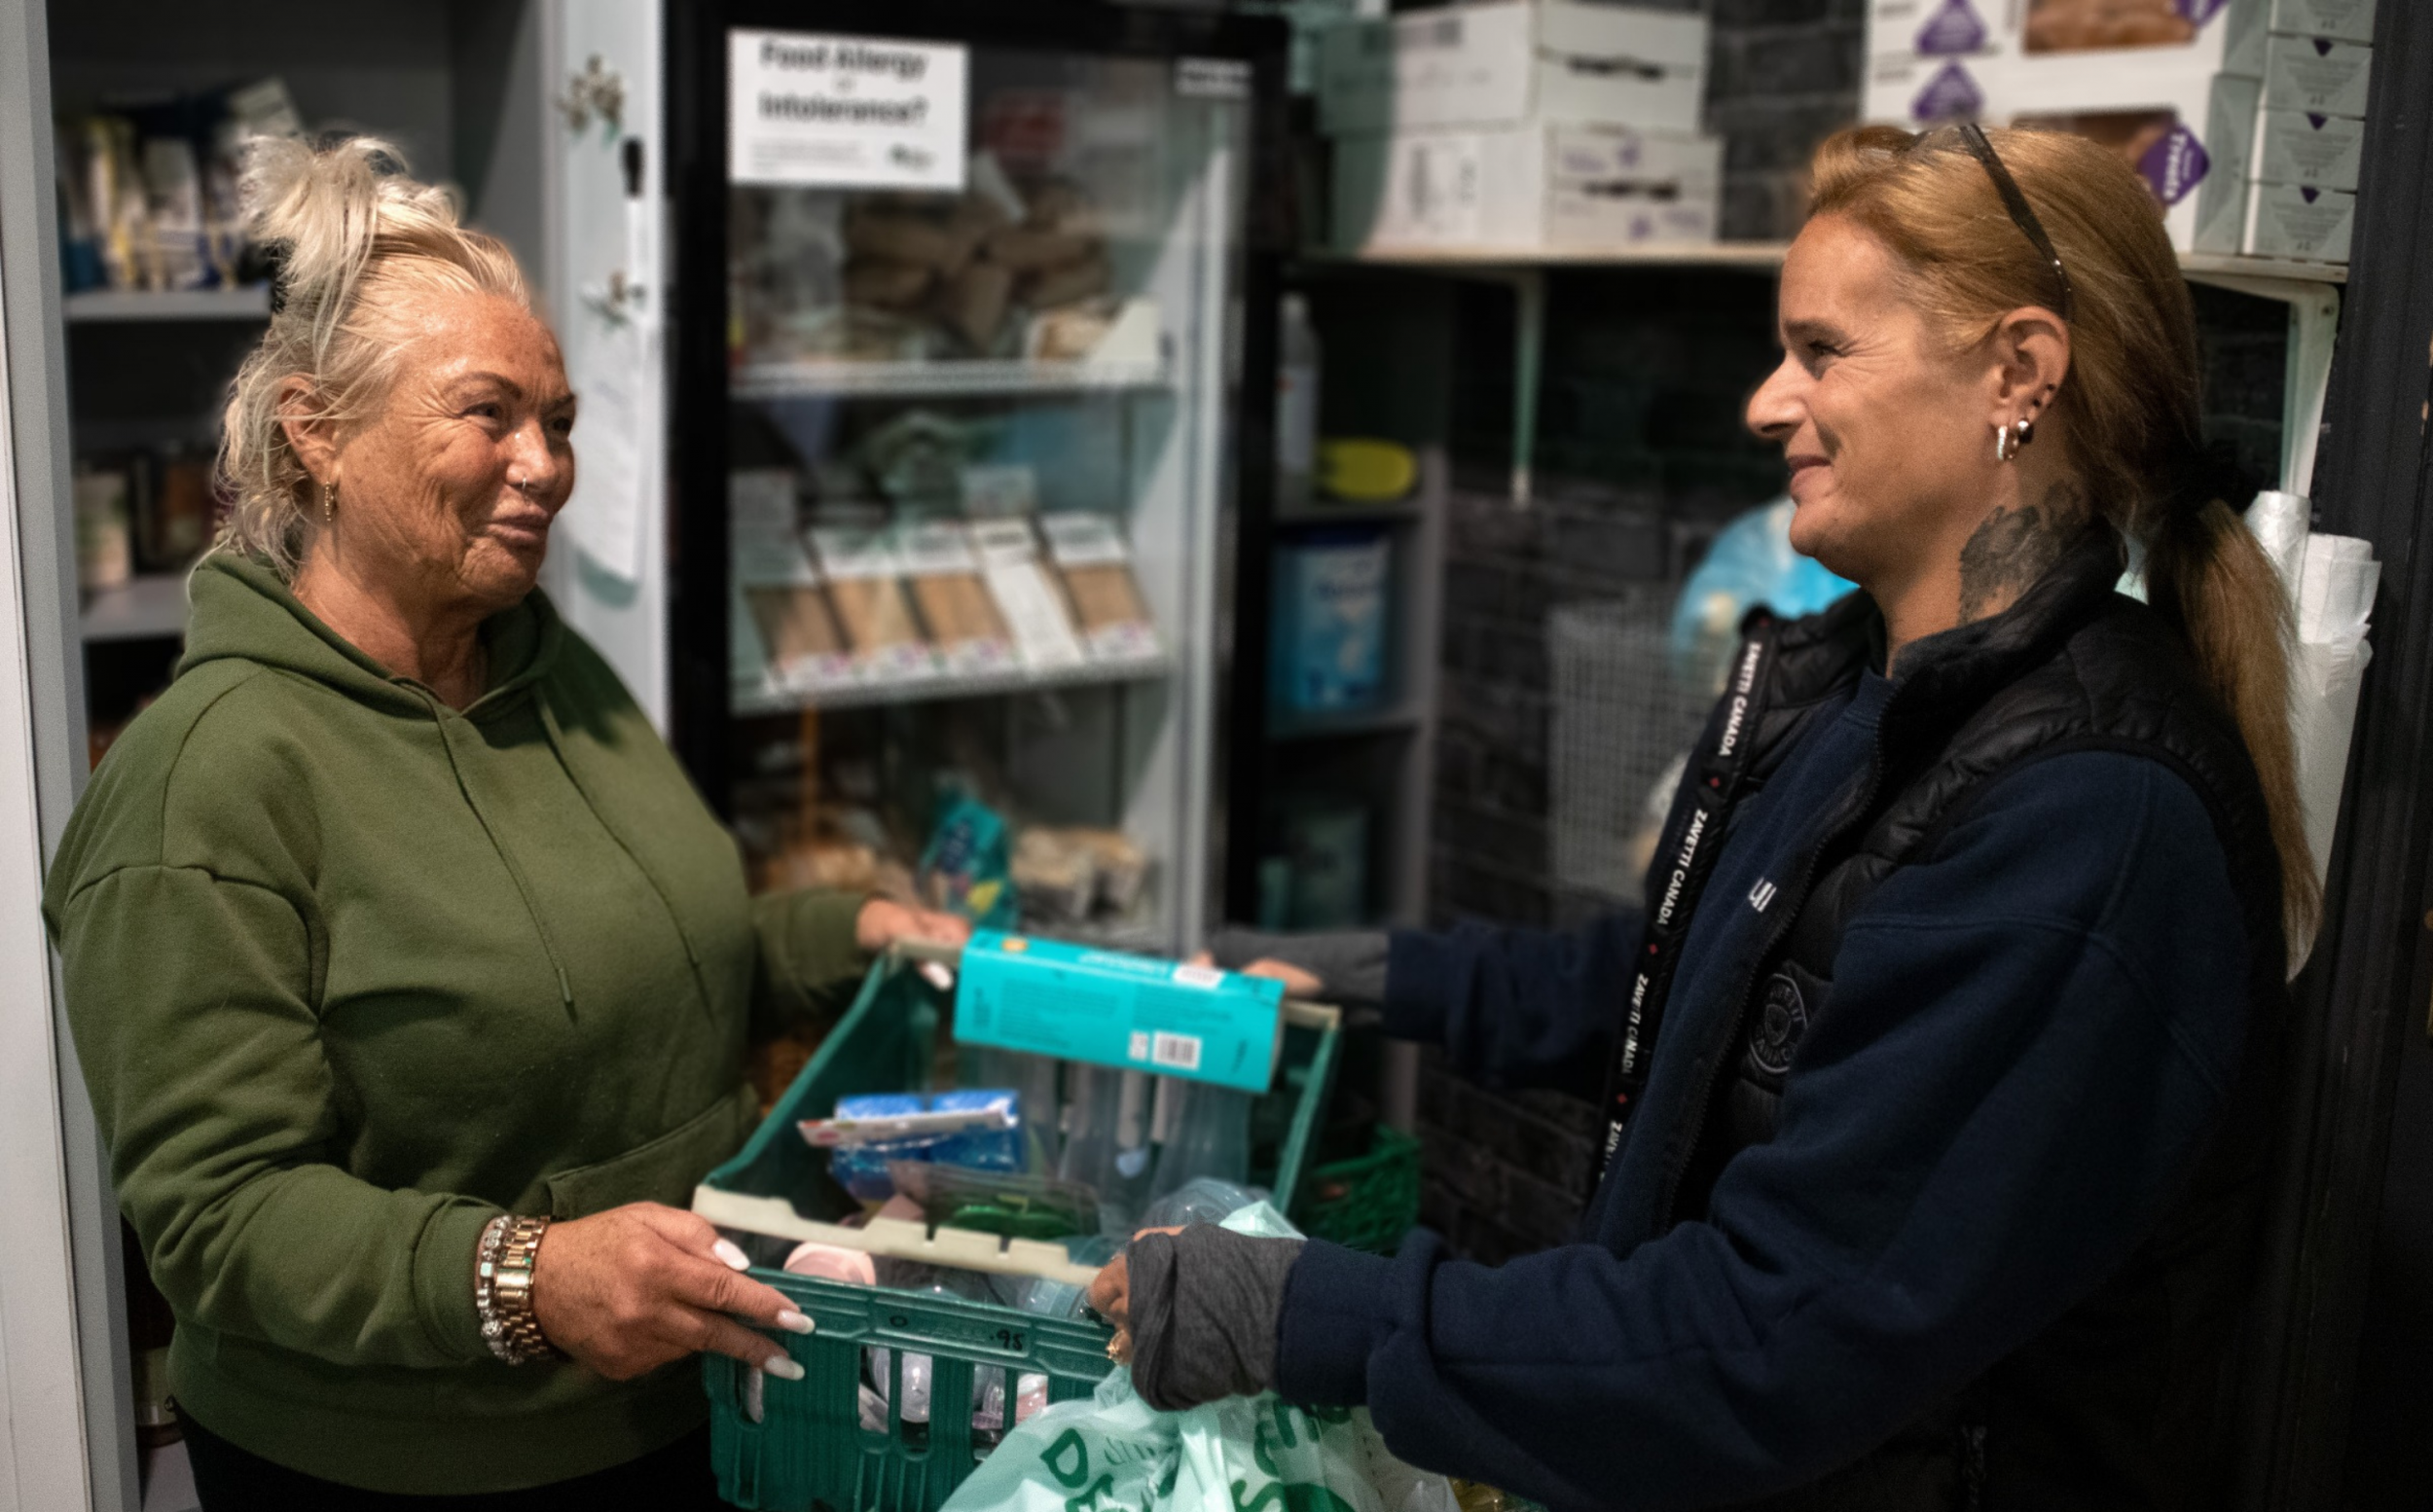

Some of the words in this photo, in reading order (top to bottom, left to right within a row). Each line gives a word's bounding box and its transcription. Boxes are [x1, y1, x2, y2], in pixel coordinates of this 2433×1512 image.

[760, 38, 827, 71] Food
[834, 45, 929, 82] Allergy
[758, 91, 928, 126] Intolerance?
[1718, 696, 1747, 756] CANADA
[1678, 810, 1708, 868] ZAVETTI
[1656, 870, 1686, 925] CANADA
